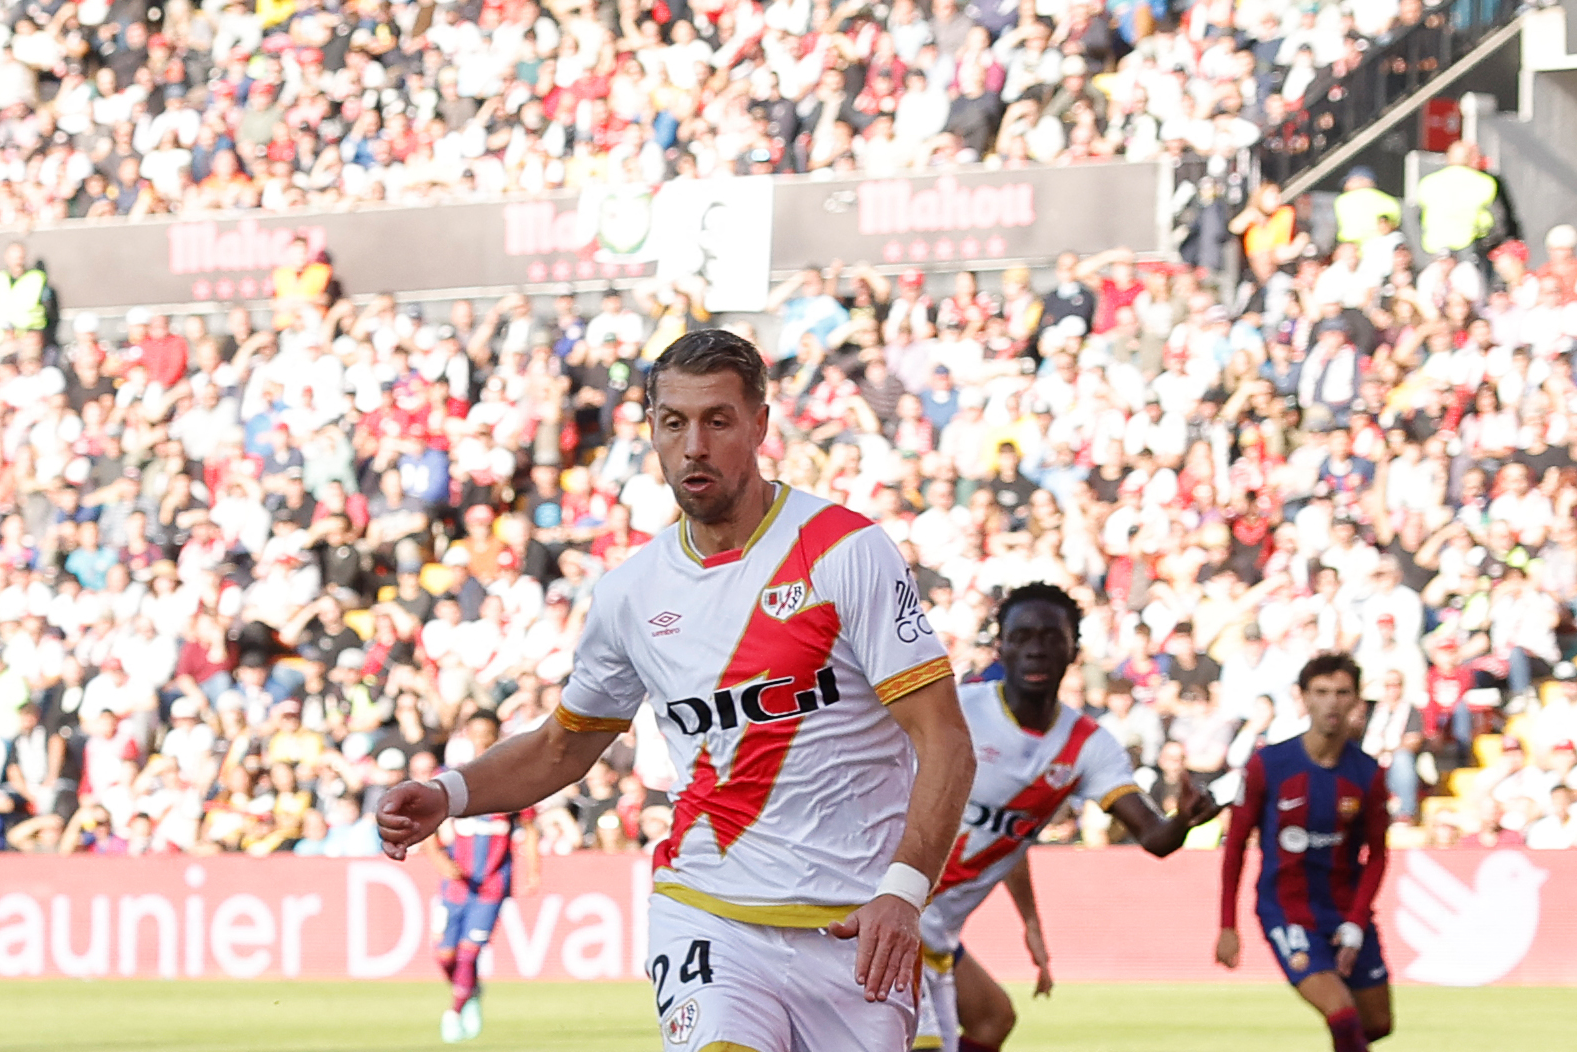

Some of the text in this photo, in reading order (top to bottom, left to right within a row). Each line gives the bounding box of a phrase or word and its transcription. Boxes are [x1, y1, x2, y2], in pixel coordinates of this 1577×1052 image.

[856, 175, 1036, 235] Mahou
[667, 666, 840, 735] DIGI
[347, 860, 653, 979] Dval
[652, 940, 713, 1017] 24
